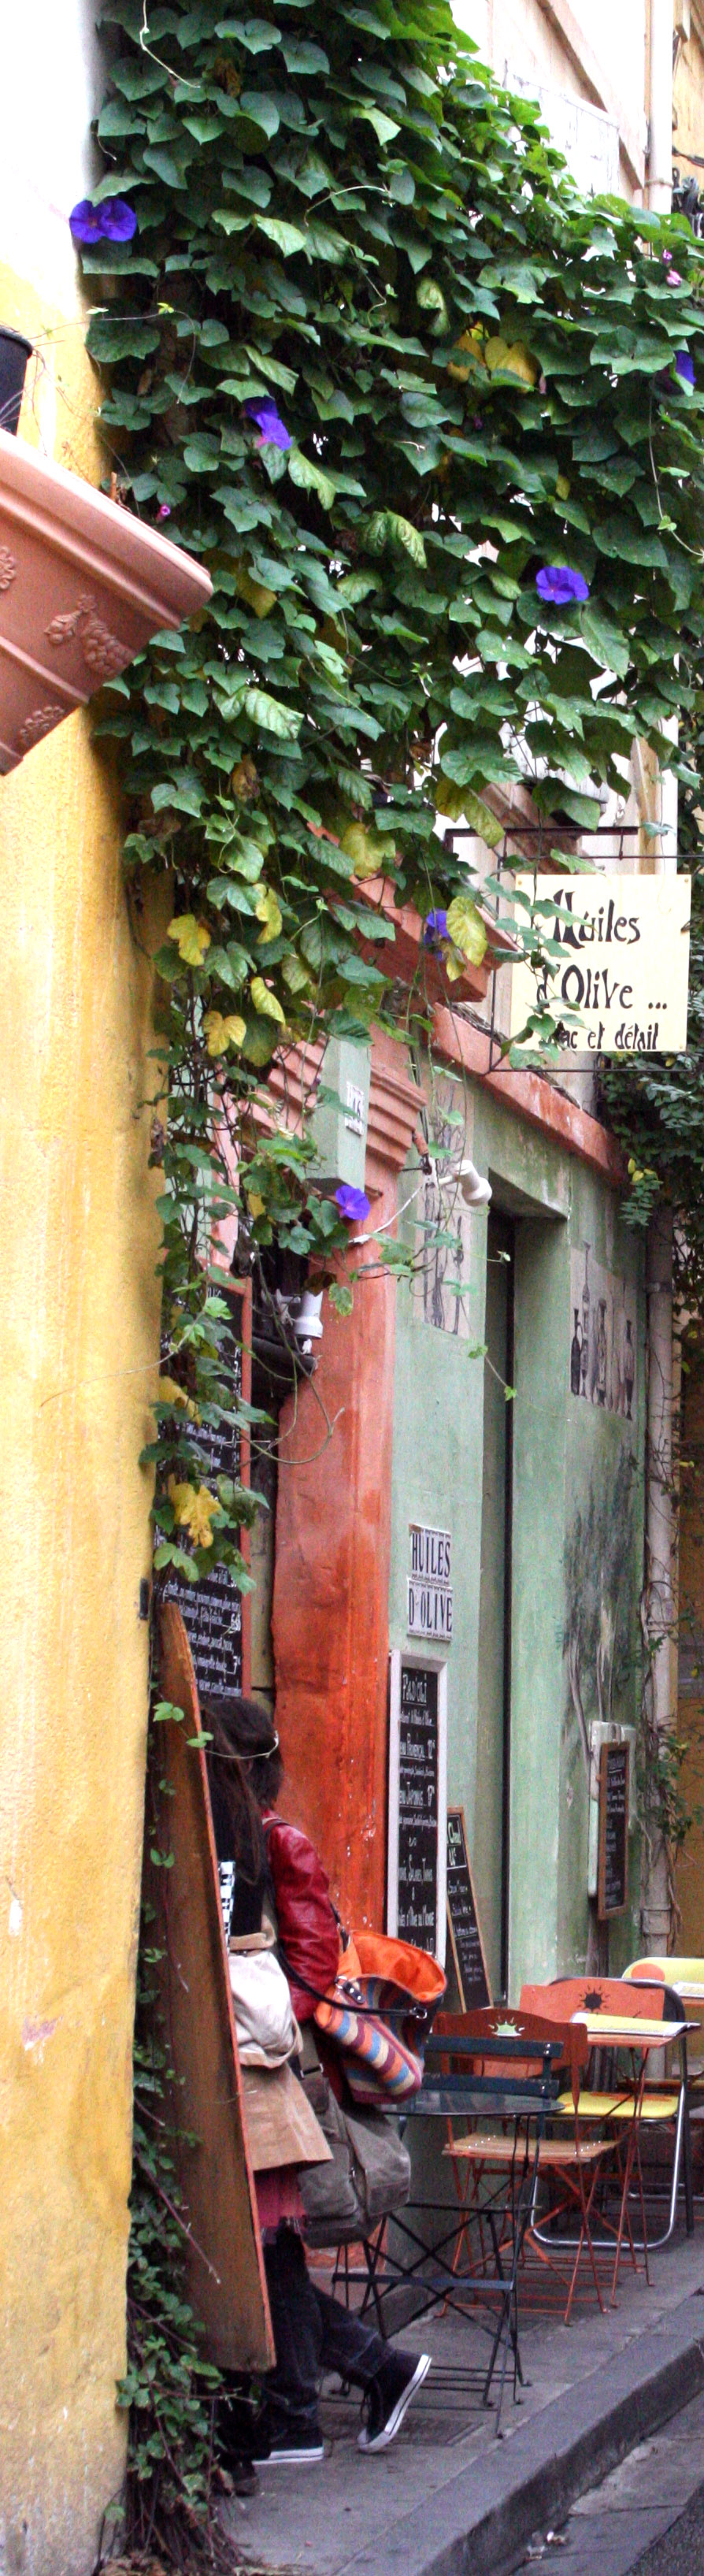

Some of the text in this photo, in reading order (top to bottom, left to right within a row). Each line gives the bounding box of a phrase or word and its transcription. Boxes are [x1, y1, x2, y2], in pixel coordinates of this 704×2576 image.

[553, 889, 641, 949] Huiles
[587, 1021, 605, 1049] et
[614, 1023, 658, 1052] détail
[412, 1532, 450, 1578] HUILES
